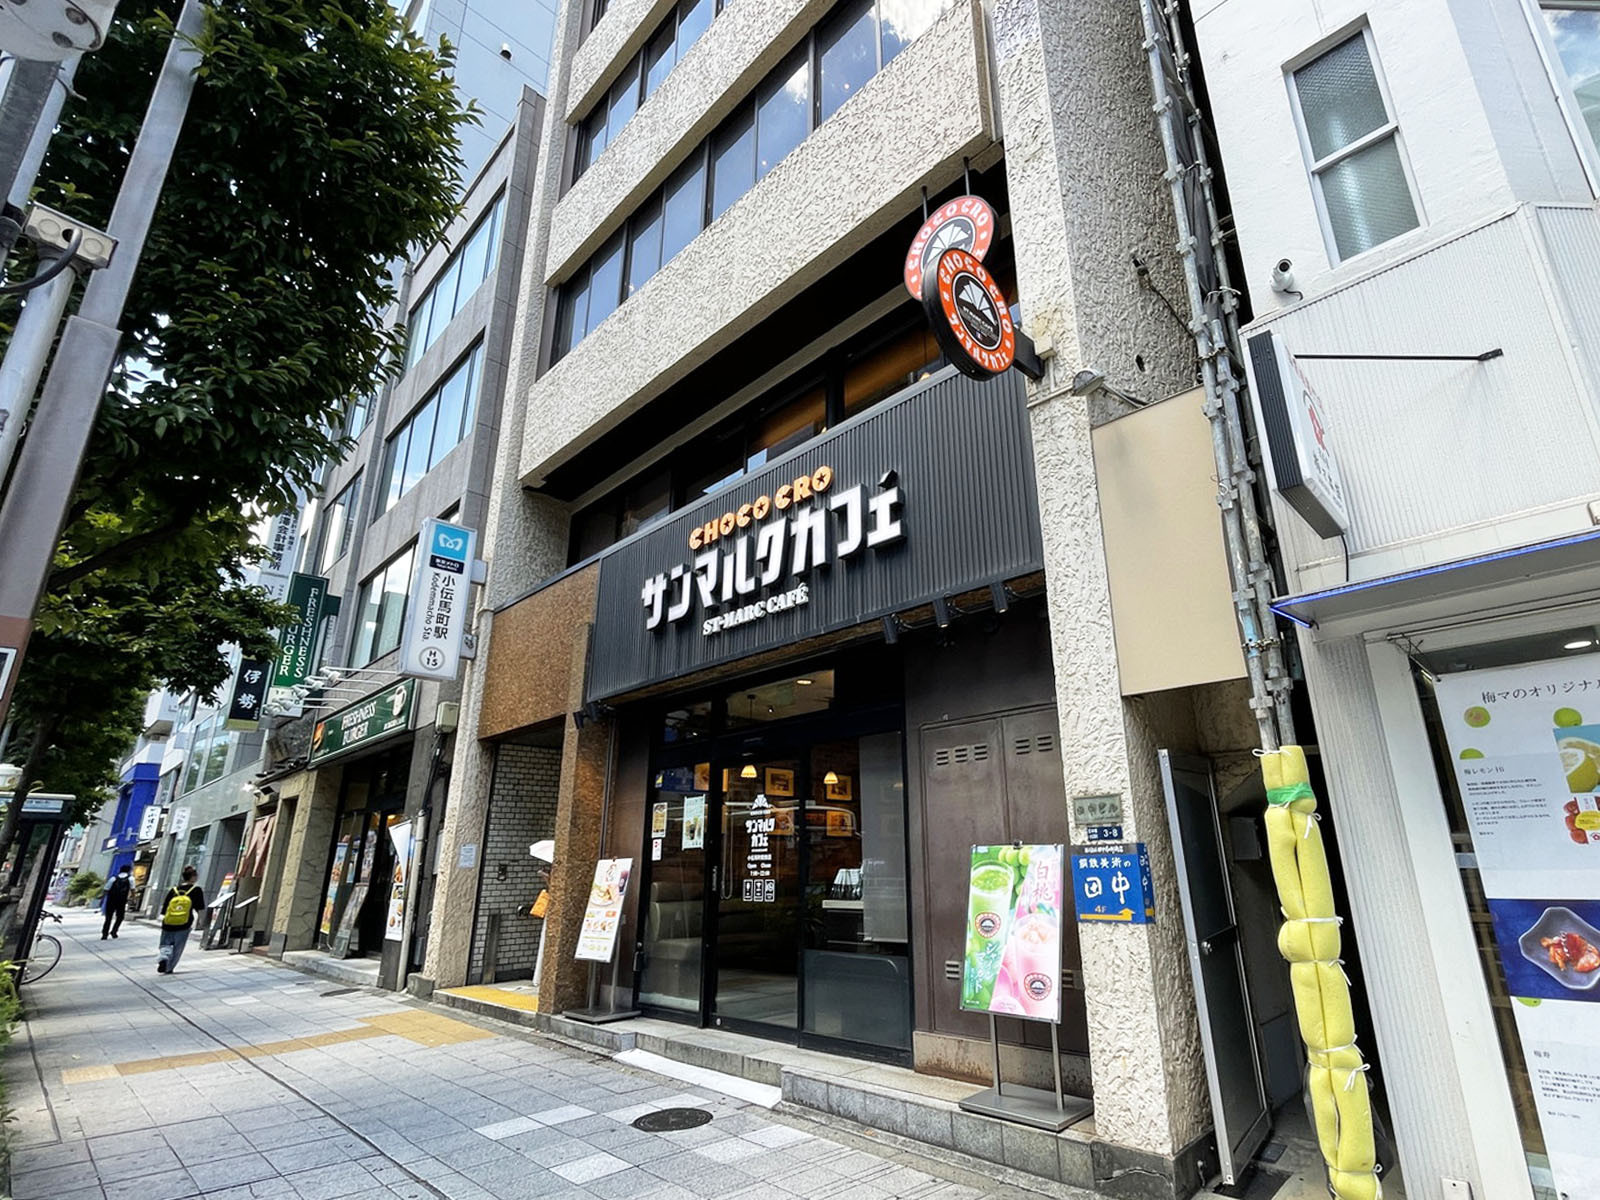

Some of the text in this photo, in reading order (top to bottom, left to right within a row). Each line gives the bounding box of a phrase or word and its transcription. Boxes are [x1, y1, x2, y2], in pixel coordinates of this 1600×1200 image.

[908, 202, 957, 271] CHOCO
[939, 251, 988, 284] CHOCO
[989, 284, 1013, 334] CRO
[689, 465, 833, 550] CHOCO CRO
[641, 469, 904, 631] サンマルクカフェ
[422, 572, 441, 642] Kodemmacho Sta.
[433, 575, 455, 640] 小伝馬町駅
[766, 582, 809, 614] CAFÉ
[293, 587, 319, 678] FRESHNESS
[426, 657, 438, 667] 15
[428, 650, 437, 658] H
[1032, 860, 1053, 903] 白桃
[1084, 871, 1130, 905] 田中
[1094, 905, 1107, 914] 4F
